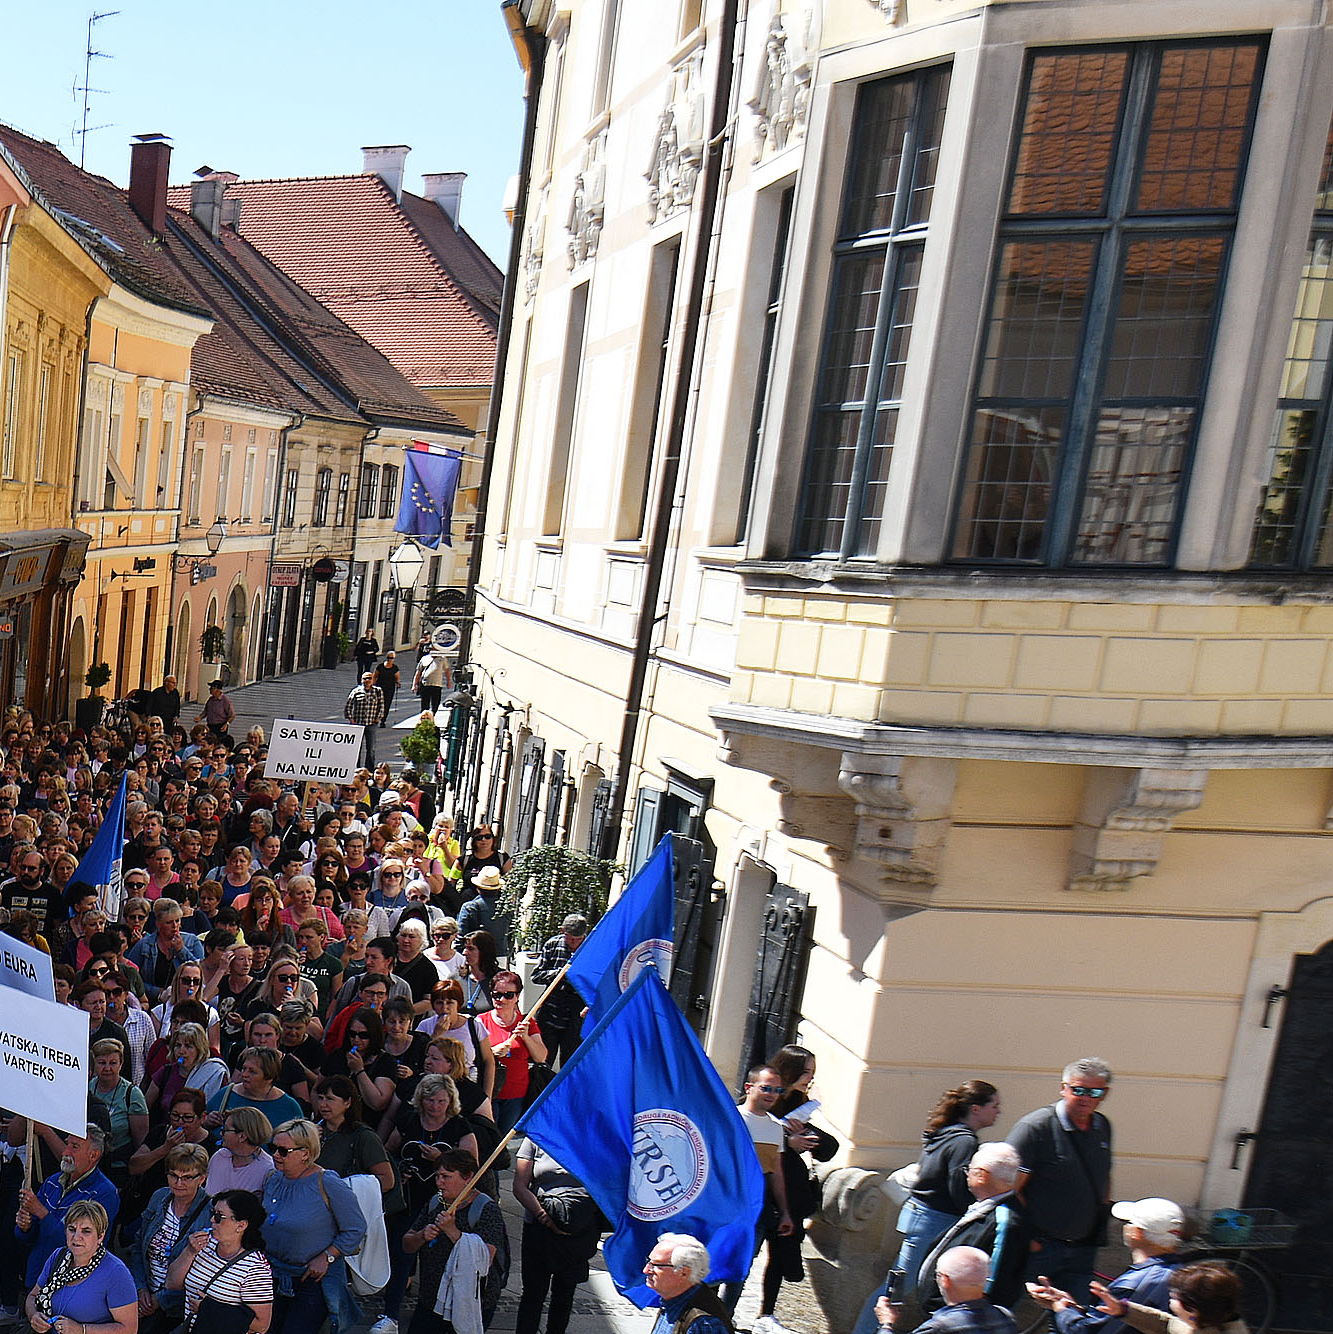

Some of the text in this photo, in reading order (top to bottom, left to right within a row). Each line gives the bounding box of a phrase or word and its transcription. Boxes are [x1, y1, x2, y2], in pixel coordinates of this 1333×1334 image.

[279, 727, 356, 744] SA ŠTITOM
[305, 747, 322, 759] ILI
[276, 762, 349, 778] NA NJEMU
[4, 952, 38, 982] EURA
[3, 1052, 55, 1082] VARTEKS
[41, 1045, 81, 1071] TREBA
